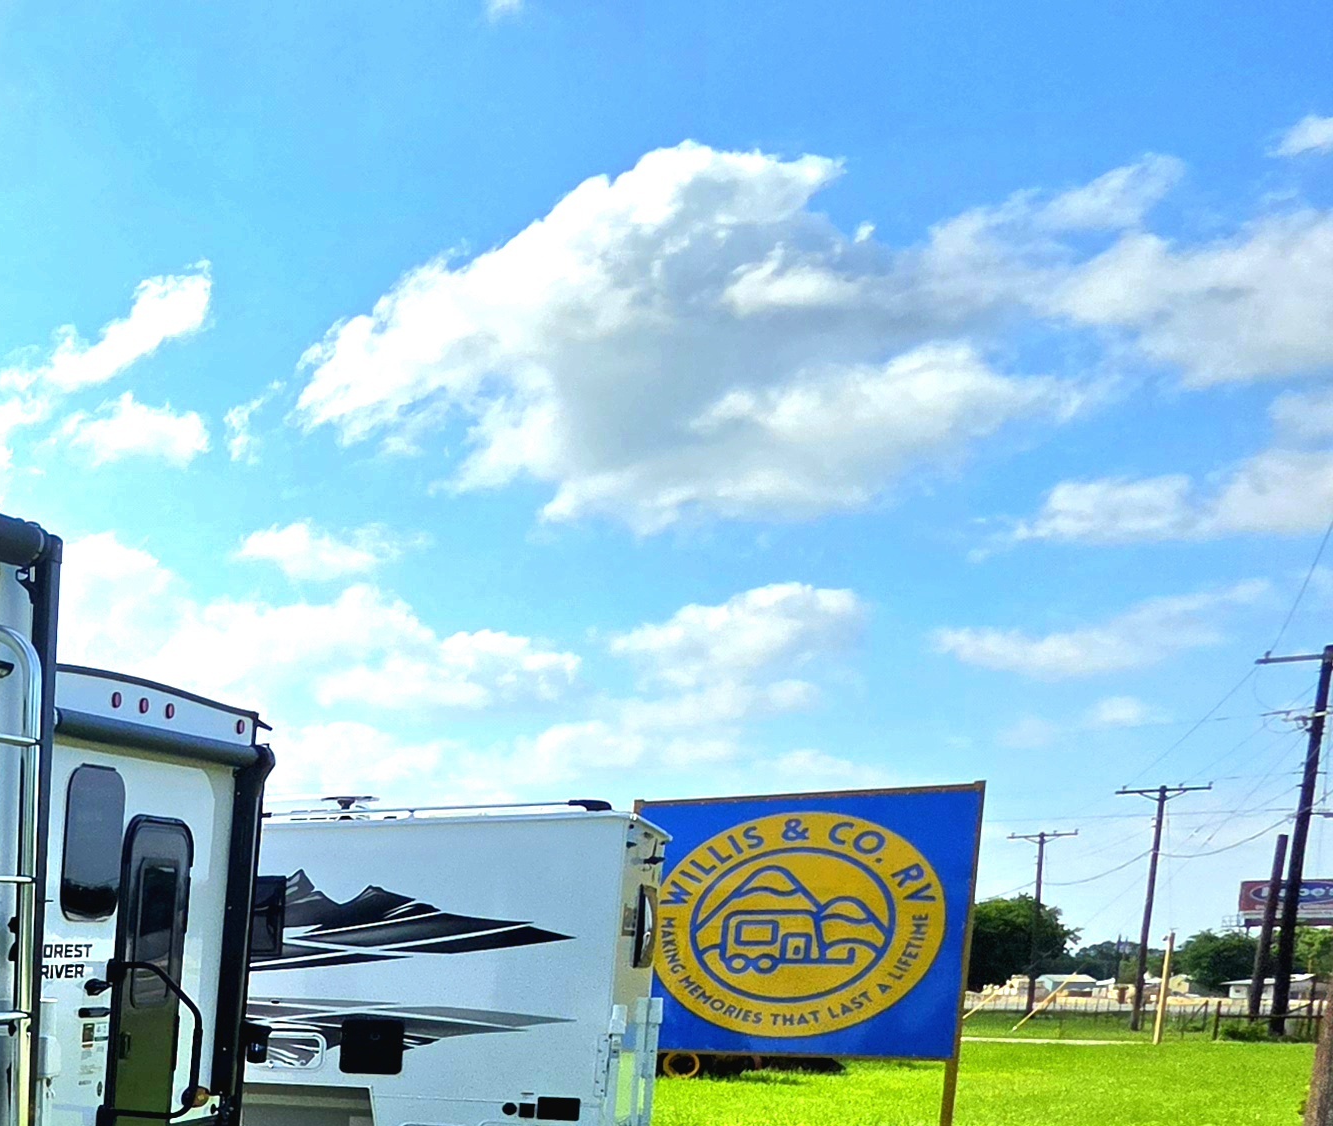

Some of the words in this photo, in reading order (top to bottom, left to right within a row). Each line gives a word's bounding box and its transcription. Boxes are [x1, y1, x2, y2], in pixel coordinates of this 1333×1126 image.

[659, 825, 764, 905] WILLIS
[780, 818, 810, 842] &
[828, 821, 887, 864] CO.
[891, 862, 937, 903] RV
[41, 963, 85, 979] RIVER
[43, 943, 93, 959] OREST
[661, 916, 685, 976] MAKING
[678, 975, 763, 1026] MEMORIES
[770, 1011, 821, 1027] THAT
[830, 993, 875, 1020] LAST
[876, 981, 892, 995] A
[889, 912, 930, 982] LIFETIME
